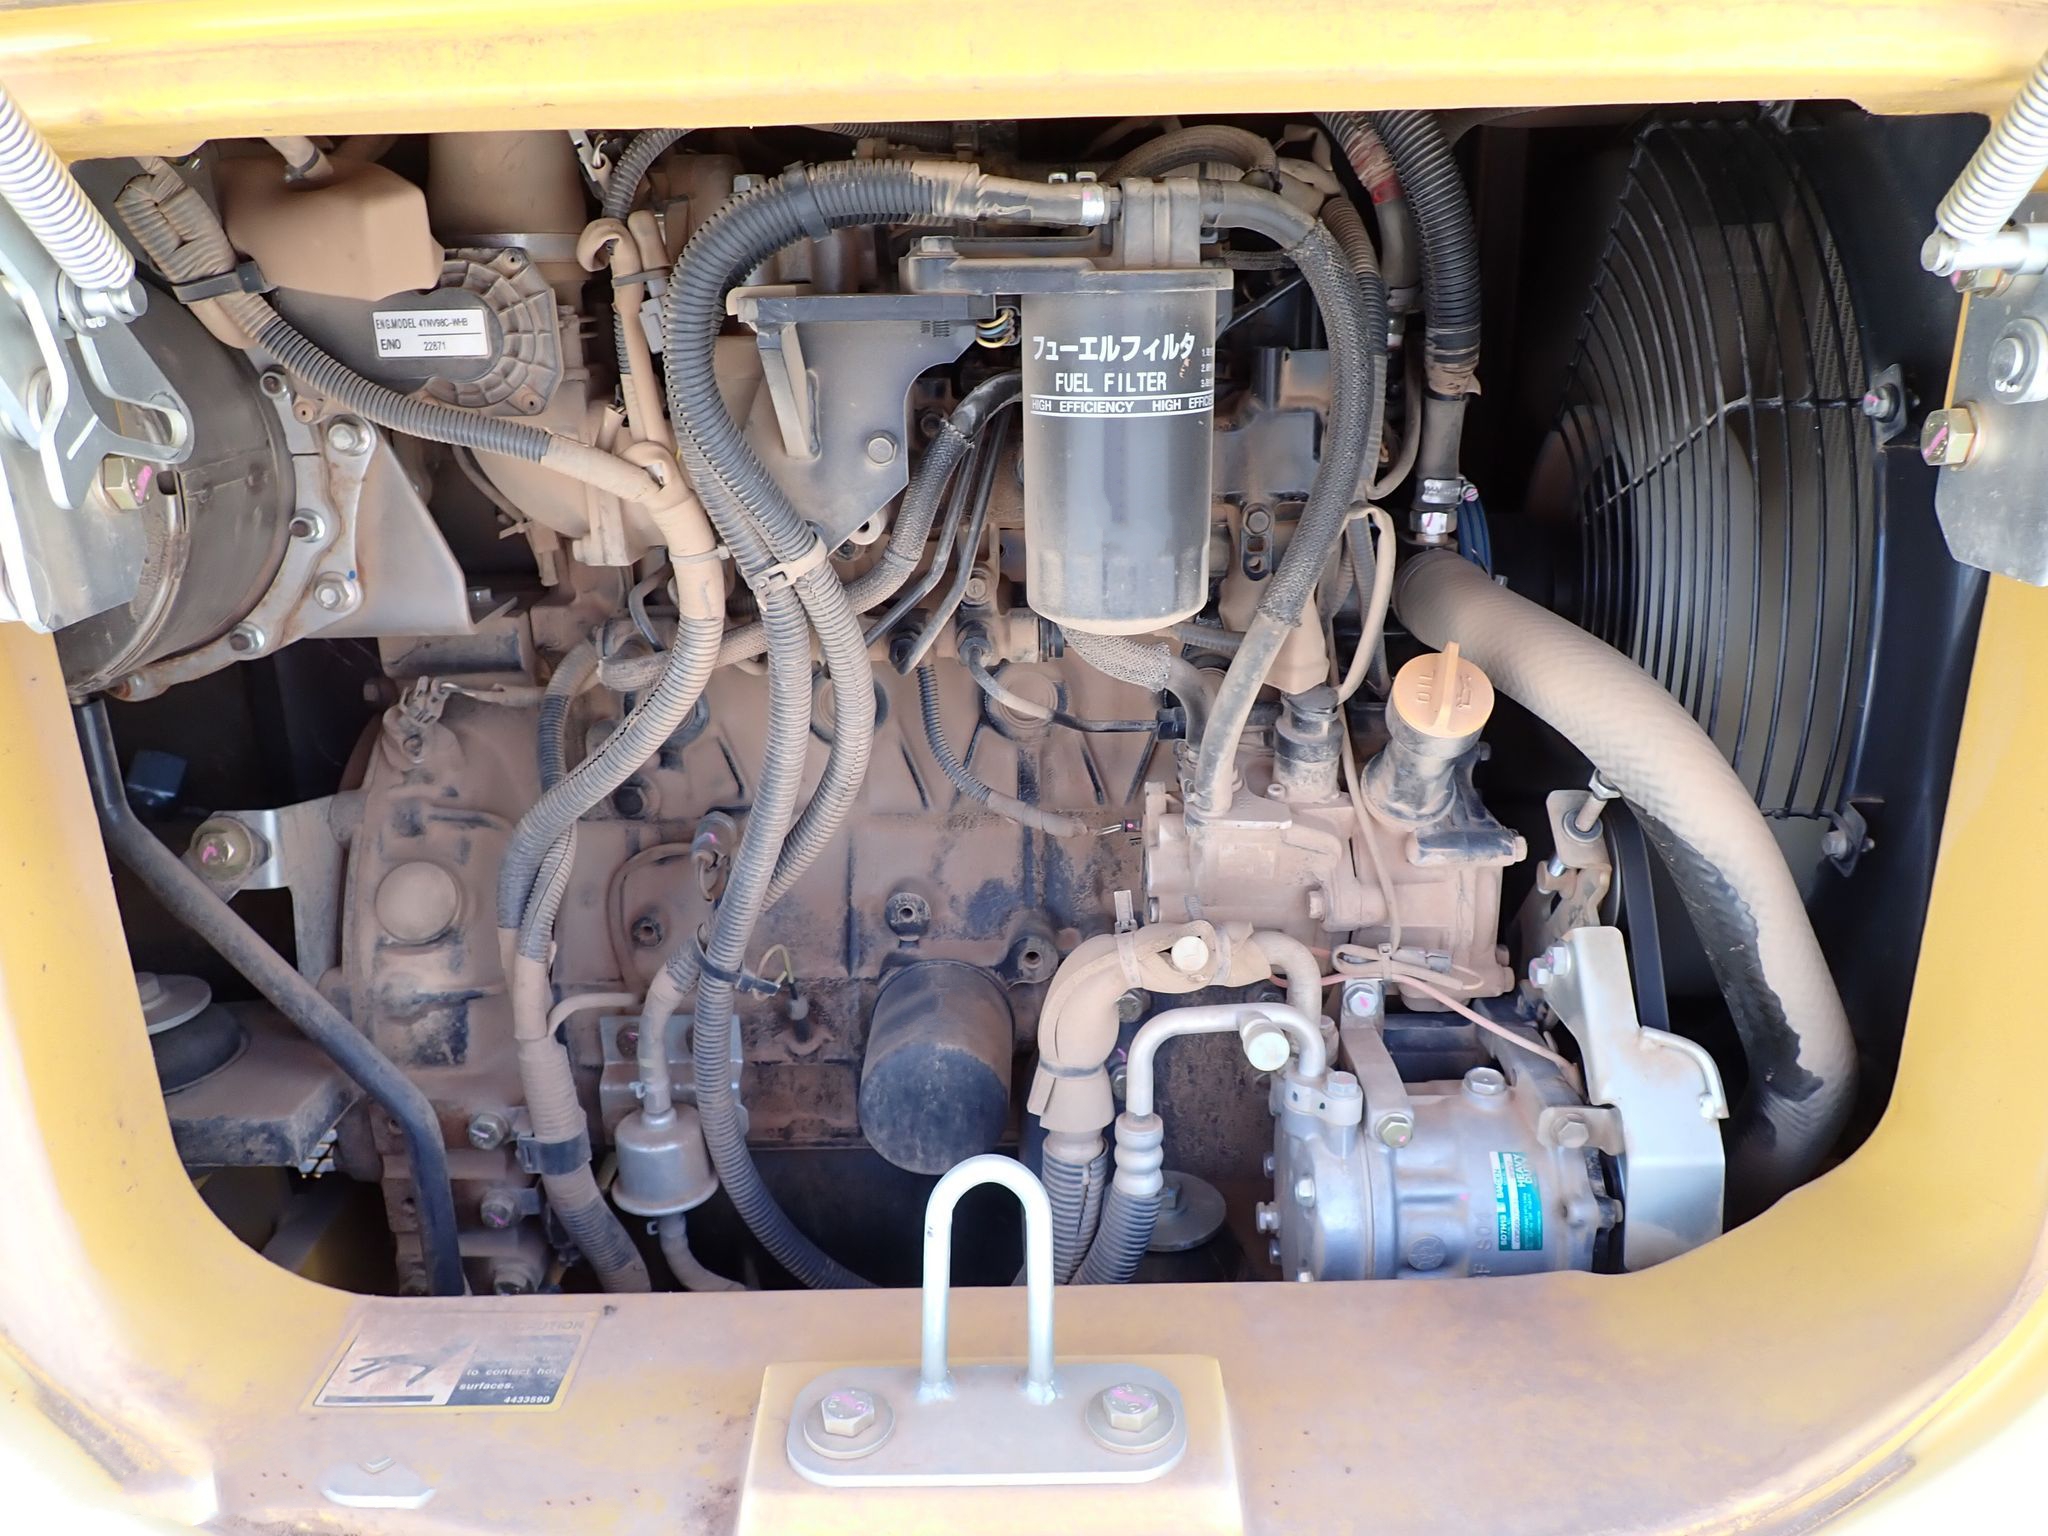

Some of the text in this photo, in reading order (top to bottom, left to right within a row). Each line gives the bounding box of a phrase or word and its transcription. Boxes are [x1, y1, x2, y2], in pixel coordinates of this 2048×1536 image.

[423, 341, 446, 351] 22871
[1032, 332, 1196, 362] フューエルフィルタ
[1055, 371, 1167, 392] FUEL FILTER
[1032, 399, 1052, 412] HIGH
[1059, 400, 1135, 413] EFFICIENCY
[1152, 398, 1182, 411] HIGH
[1416, 670, 1436, 704] OIL
[1512, 1153, 1527, 1188] HEAVY
[467, 1368, 479, 1376] to
[486, 1367, 530, 1376] contact
[459, 1381, 514, 1390] surfaces.
